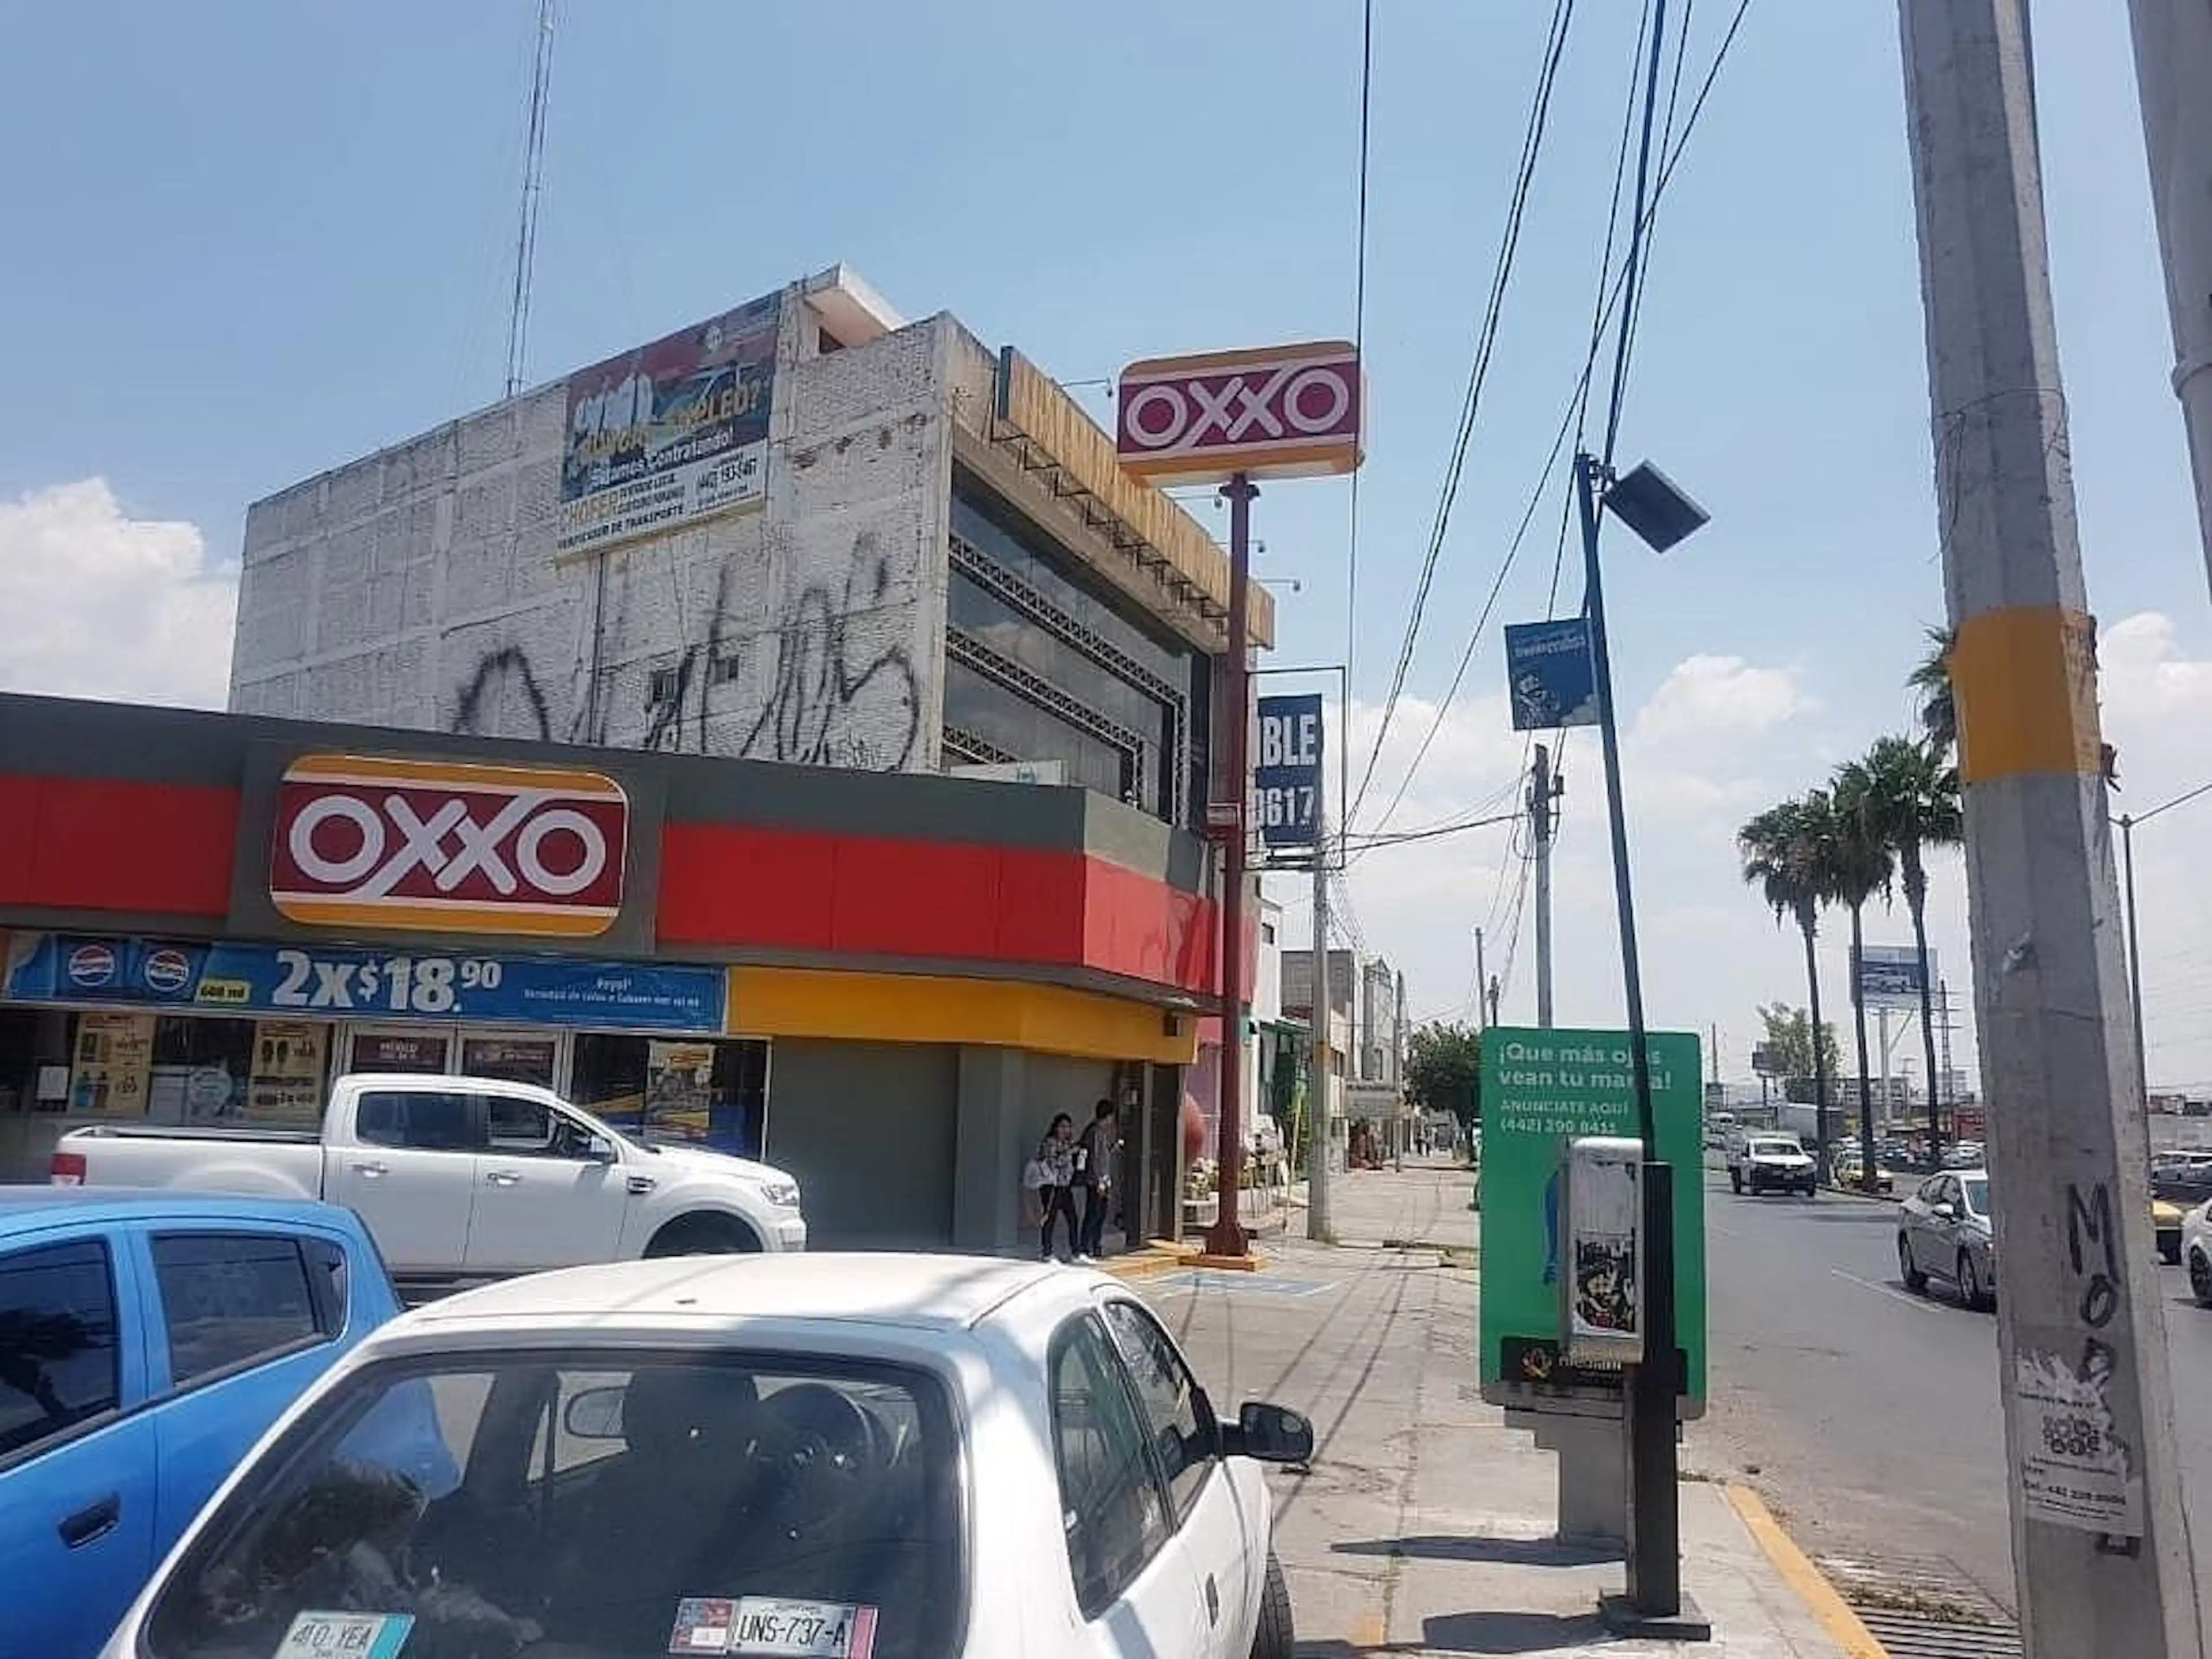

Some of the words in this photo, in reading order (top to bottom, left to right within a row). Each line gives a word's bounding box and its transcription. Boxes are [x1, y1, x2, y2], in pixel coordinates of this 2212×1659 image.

[1126, 365, 1350, 453] OXXO
[1257, 714, 1317, 767] BLE
[289, 791, 607, 899] OXXO
[1559, 1046, 1605, 1065] más
[1612, 1047, 1661, 1069] ojs
[1499, 1072, 1553, 1086] vean
[1560, 1070, 1584, 1087] tu
[1590, 1071, 1671, 1090] mara!
[738, 1614, 846, 1647] UNS-737-A
